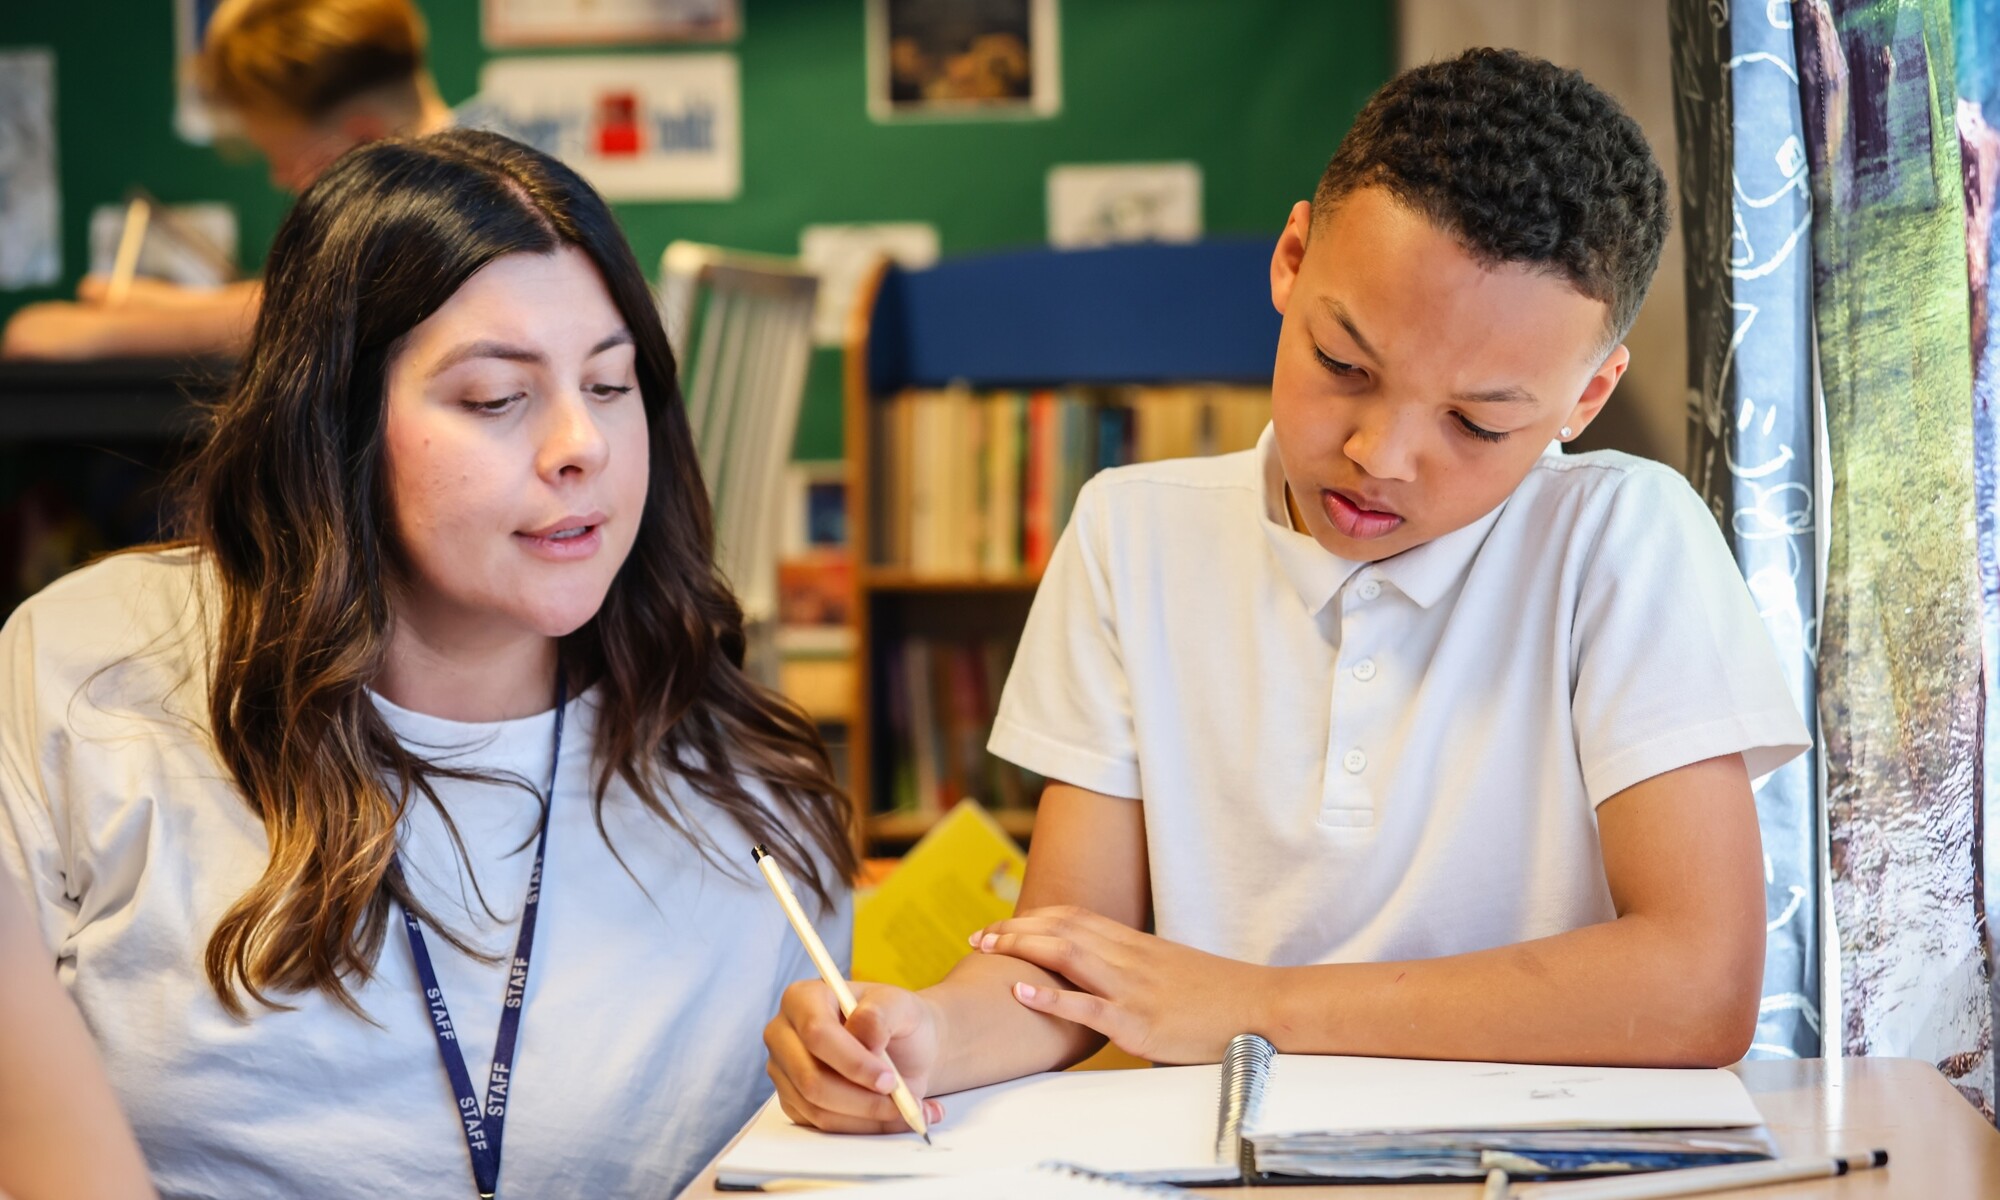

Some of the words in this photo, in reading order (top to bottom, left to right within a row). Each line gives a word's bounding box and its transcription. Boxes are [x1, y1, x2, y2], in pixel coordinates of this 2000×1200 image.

[506, 957, 528, 1008] STAFF
[427, 988, 455, 1040] STAFF
[487, 1063, 510, 1117] STAFF
[460, 1097, 488, 1151] STAFF
